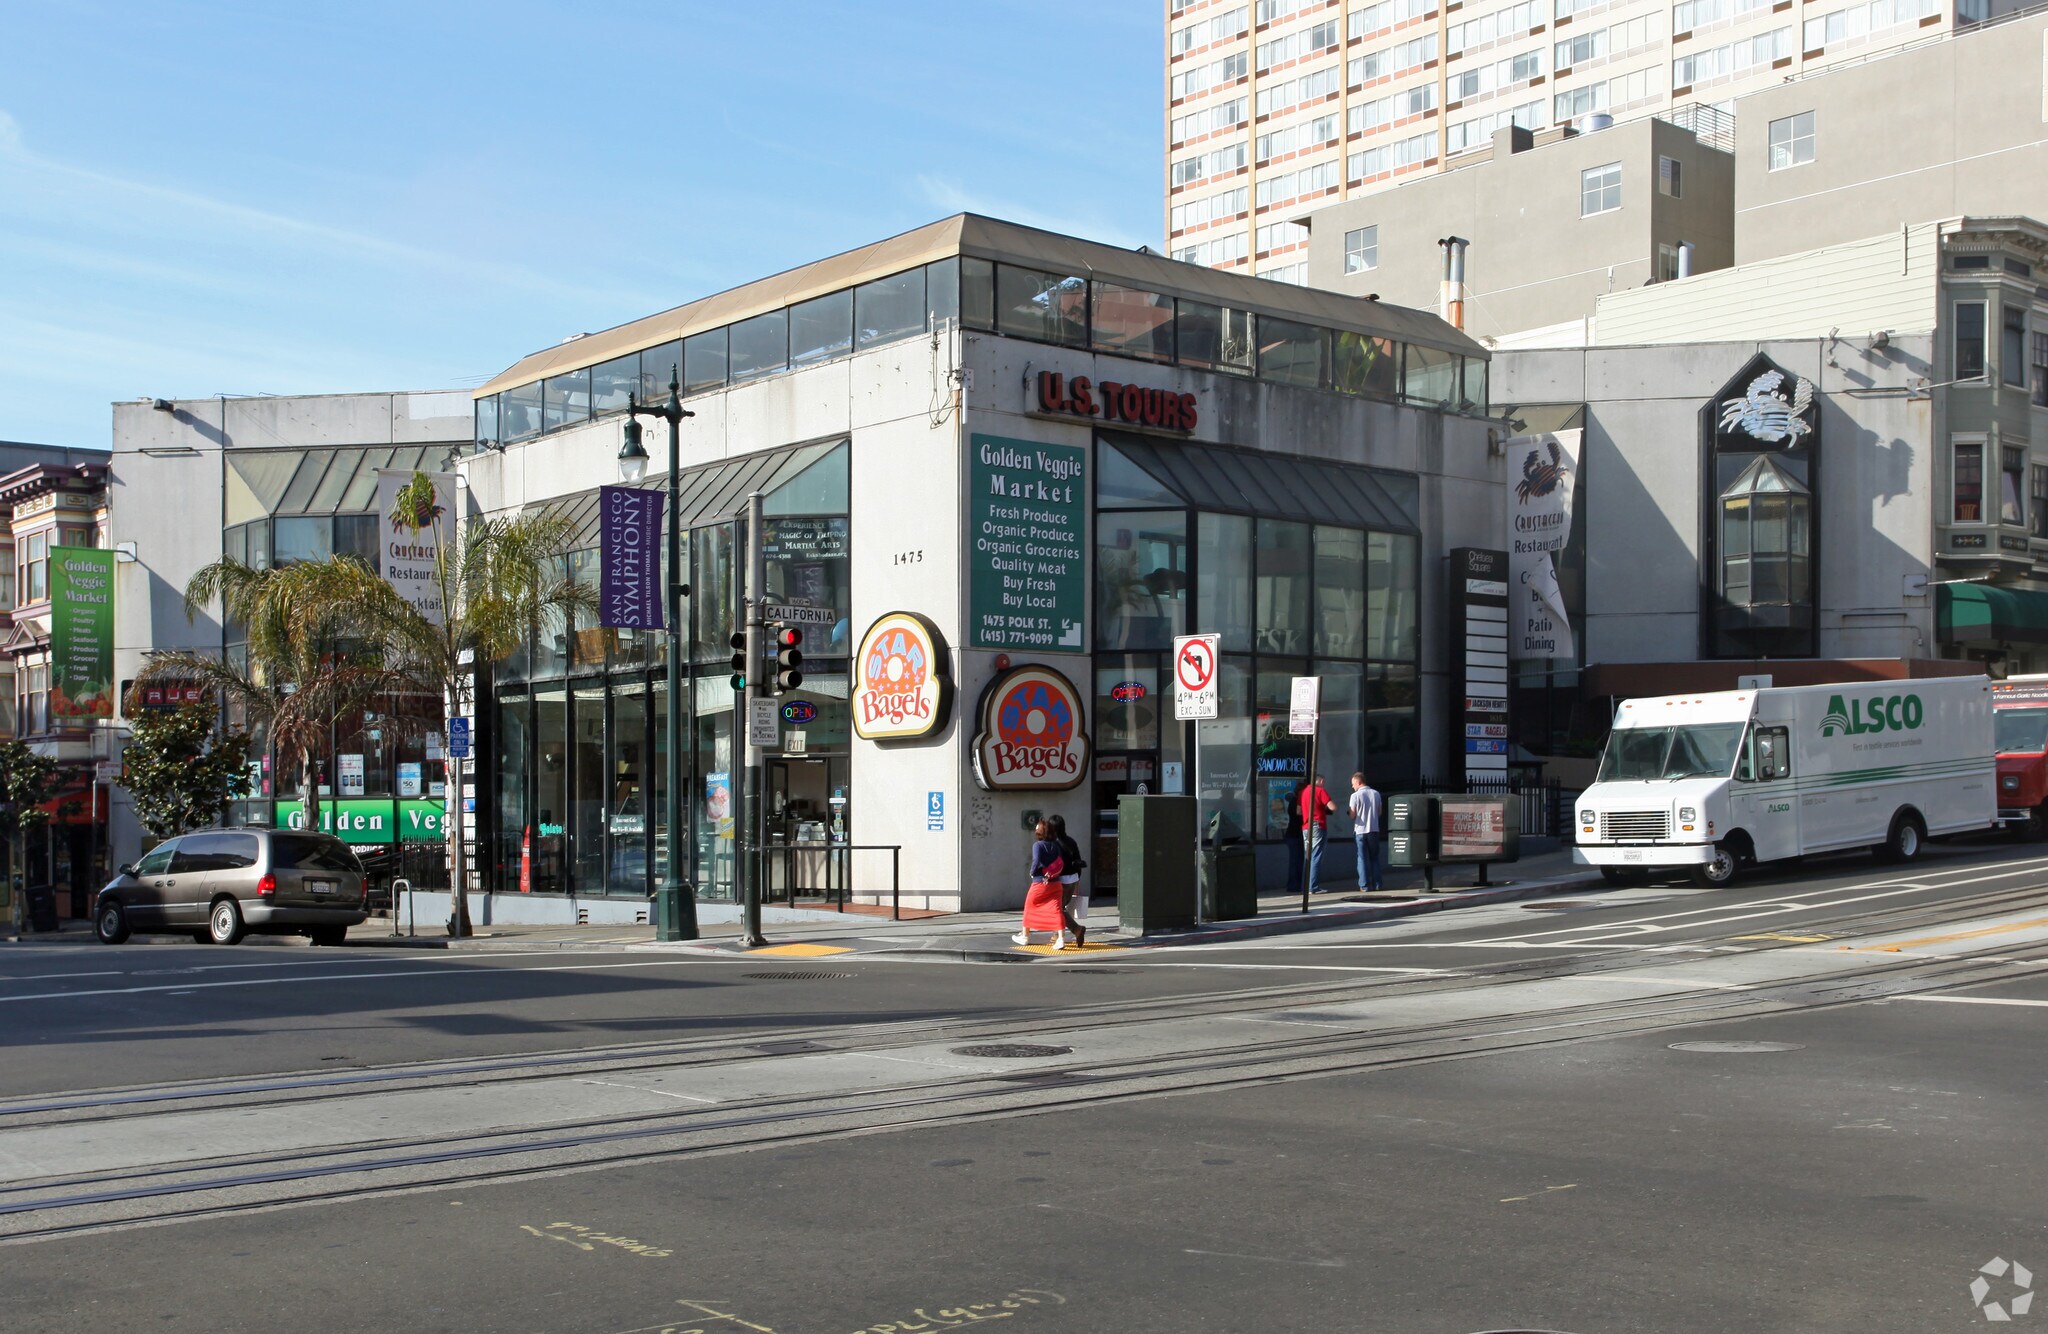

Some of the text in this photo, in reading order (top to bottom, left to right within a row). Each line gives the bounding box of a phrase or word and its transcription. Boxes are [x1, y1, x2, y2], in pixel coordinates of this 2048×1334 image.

[1038, 370, 1198, 431] U.S. TOURS
[980, 443, 1082, 480] Golden Veggie
[990, 474, 1073, 504] Market
[990, 504, 1068, 525] Fresh Produce
[982, 521, 1075, 543] Organic Produce
[389, 542, 437, 560] CRUSTACE
[785, 541, 841, 549] MARTIAL ARTS
[977, 538, 1080, 560] Organic Groceries
[64, 560, 107, 573] Golden
[611, 492, 622, 624] SAN FRANCISCO
[623, 491, 641, 626] SYMPHONY
[893, 550, 923, 566] 1475
[991, 556, 1066, 575] Quality Meat
[68, 574, 106, 590] Veggie
[1003, 575, 1056, 592] Buy Fresh
[64, 590, 108, 604] Market
[1003, 592, 1056, 609] Buy Local
[767, 607, 834, 623] CALIFORNIA
[983, 614, 1052, 630] 1475 POLK ST.
[980, 628, 1054, 645] (415) 771-9099
[1525, 636, 1555, 653] Dining
[73, 655, 98, 663] Grocery
[868, 632, 925, 681] STAR
[1112, 687, 1145, 699] OPEN
[785, 706, 813, 718] OPEN
[860, 684, 931, 725] Bagels
[1002, 685, 1071, 731] STAR
[1819, 694, 1923, 738] ALSCO
[1467, 725, 1507, 737] STAR BAGELS
[787, 739, 804, 751] EXIT
[991, 741, 1078, 778] Bagels
[1256, 757, 1306, 772] SANDWICHES
[1768, 803, 1790, 813] ALSCO
[287, 810, 383, 830] Glden
[1453, 822, 1490, 832] COVERAGE
